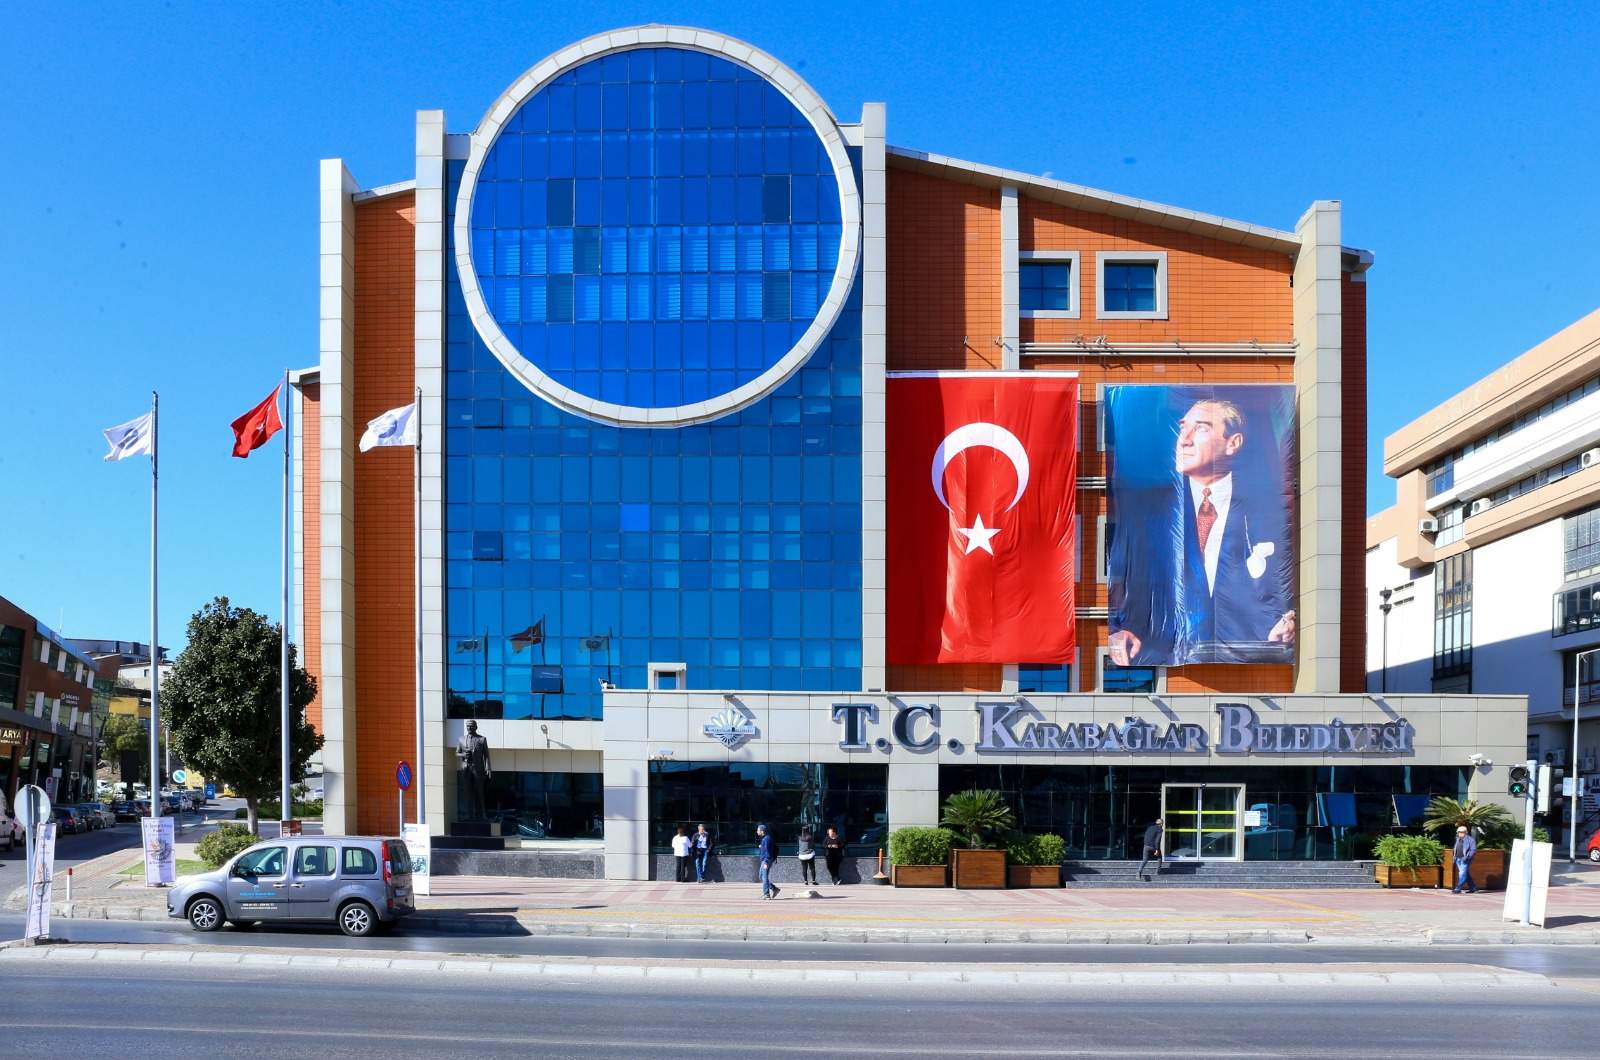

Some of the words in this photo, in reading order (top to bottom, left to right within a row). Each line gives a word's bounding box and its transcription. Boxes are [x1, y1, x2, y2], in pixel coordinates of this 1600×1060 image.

[2, 729, 22, 739] ARYA
[832, 703, 961, 753] T.C.
[977, 703, 1207, 752] KARABAĞLAR
[1216, 704, 1408, 752] BELEDİYESİ
